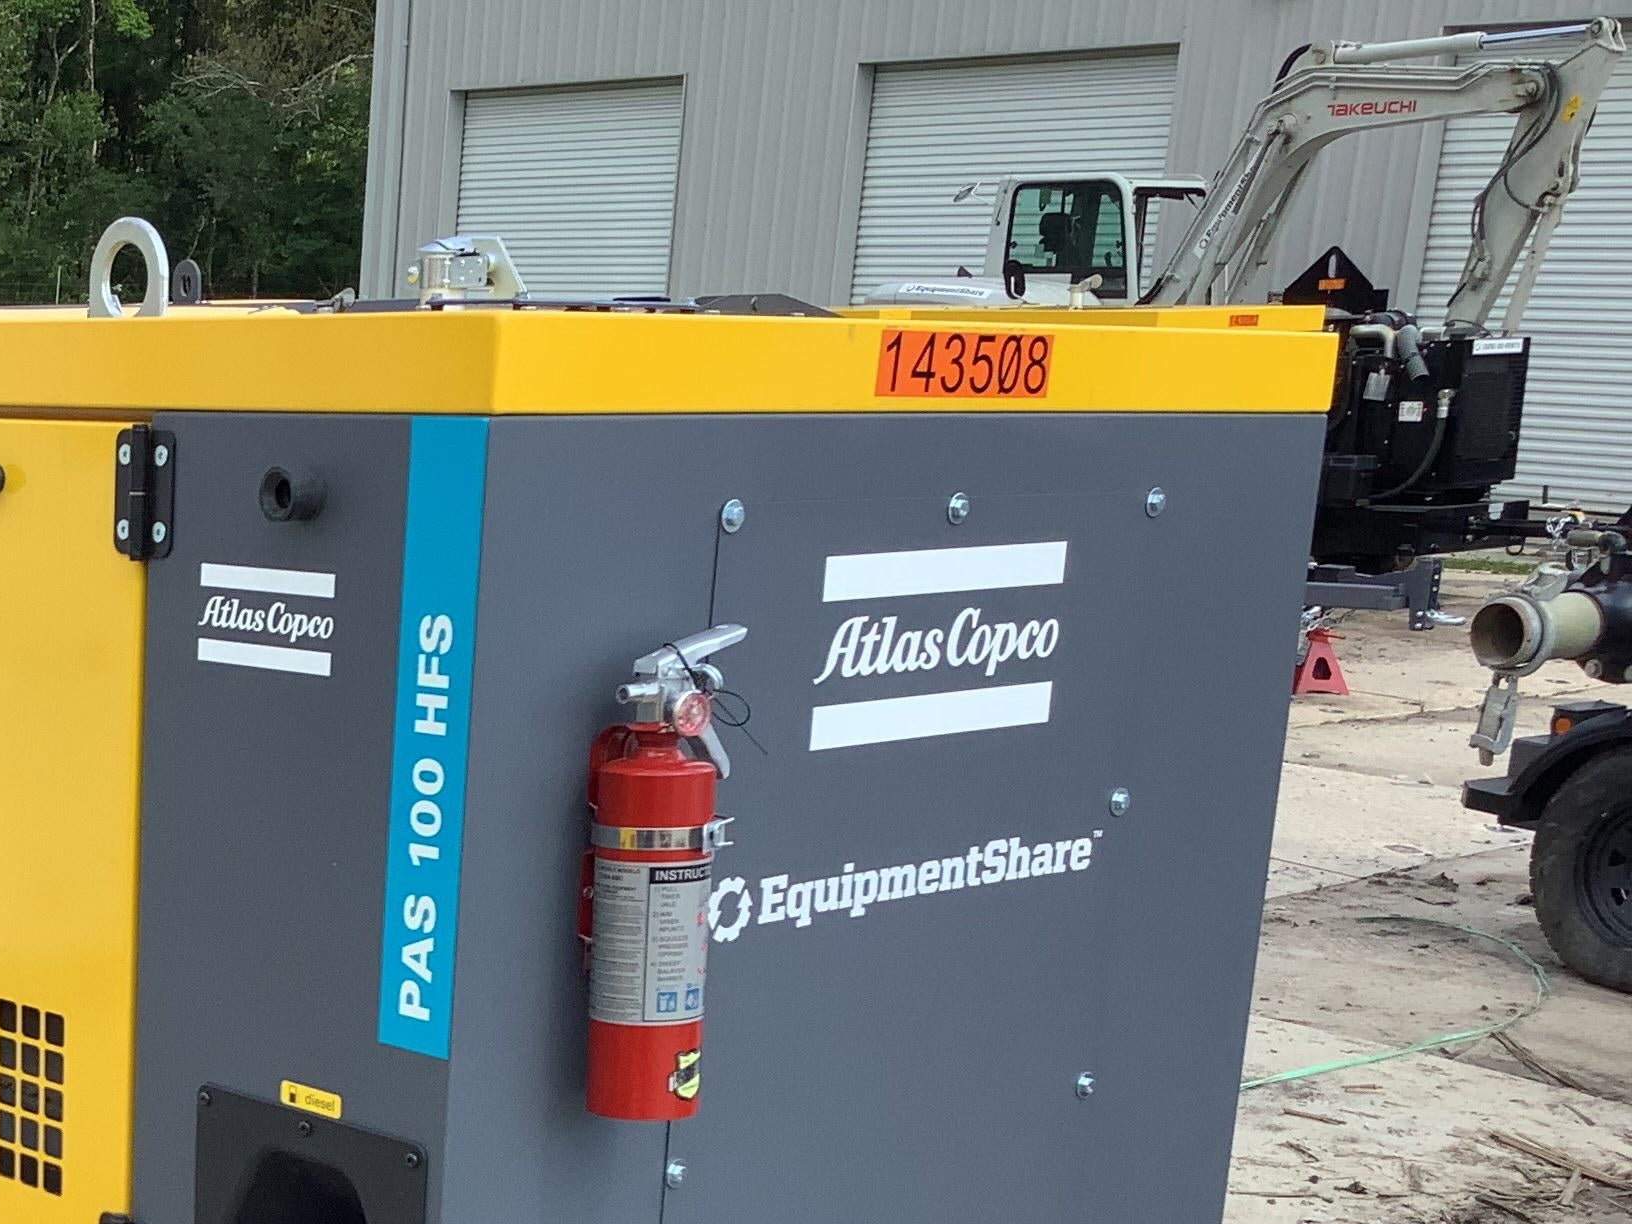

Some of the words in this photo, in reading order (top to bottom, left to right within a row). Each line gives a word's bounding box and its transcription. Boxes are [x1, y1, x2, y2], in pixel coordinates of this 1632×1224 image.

[885, 331, 1050, 395] 143508
[197, 595, 265, 632] Atlas
[267, 601, 334, 643] Copco
[813, 615, 943, 685] Atlas
[945, 607, 1060, 677] Copco
[414, 614, 454, 736] HFS
[409, 757, 445, 867] 100
[757, 836, 1092, 928] EquipmentShare
[398, 894, 438, 1021] PAS
[304, 1094, 336, 1112] diesel
